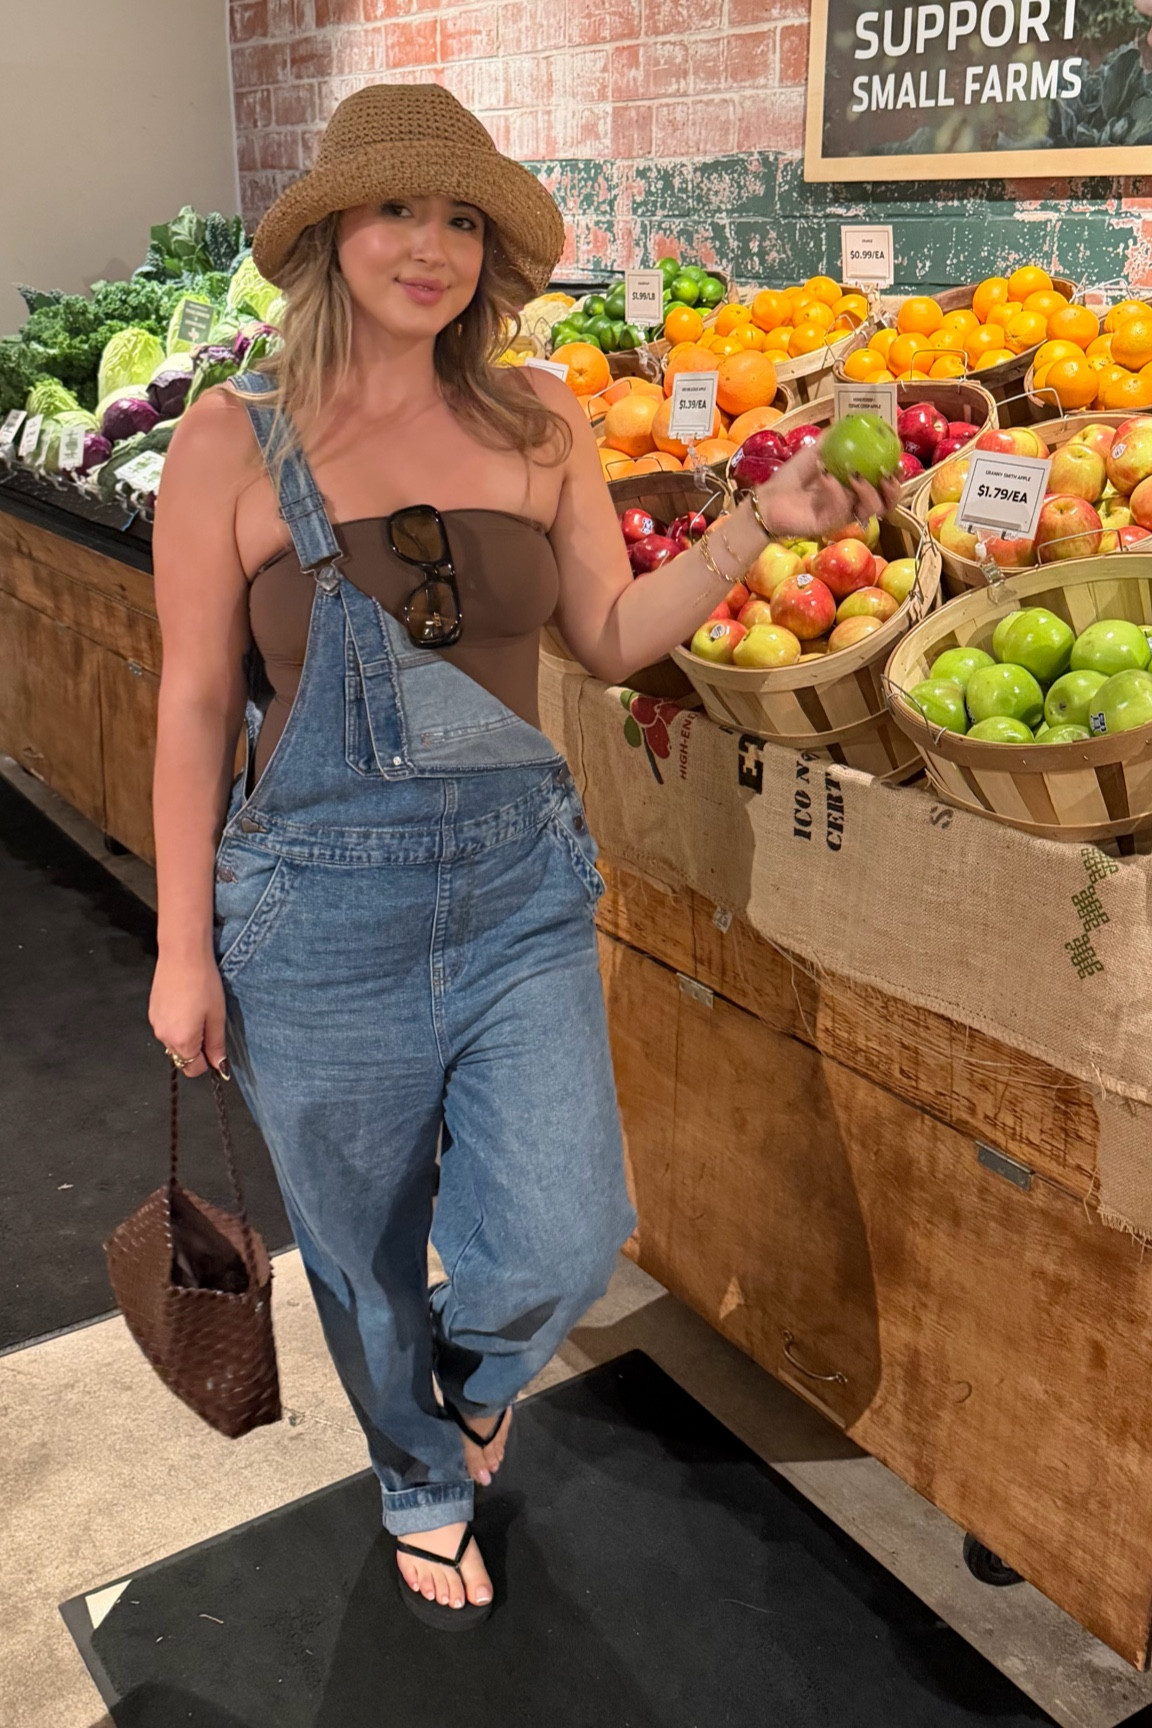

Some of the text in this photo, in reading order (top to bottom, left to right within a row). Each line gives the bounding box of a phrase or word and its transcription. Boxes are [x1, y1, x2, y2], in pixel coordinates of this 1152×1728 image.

[852, 57, 1082, 112] SMALL FARMS
[850, 250, 885, 260] $0.99/EA
[679, 399, 707, 410] $1.39/EA
[977, 484, 1028, 503] $1.79/EA
[794, 790, 813, 841] ICO
